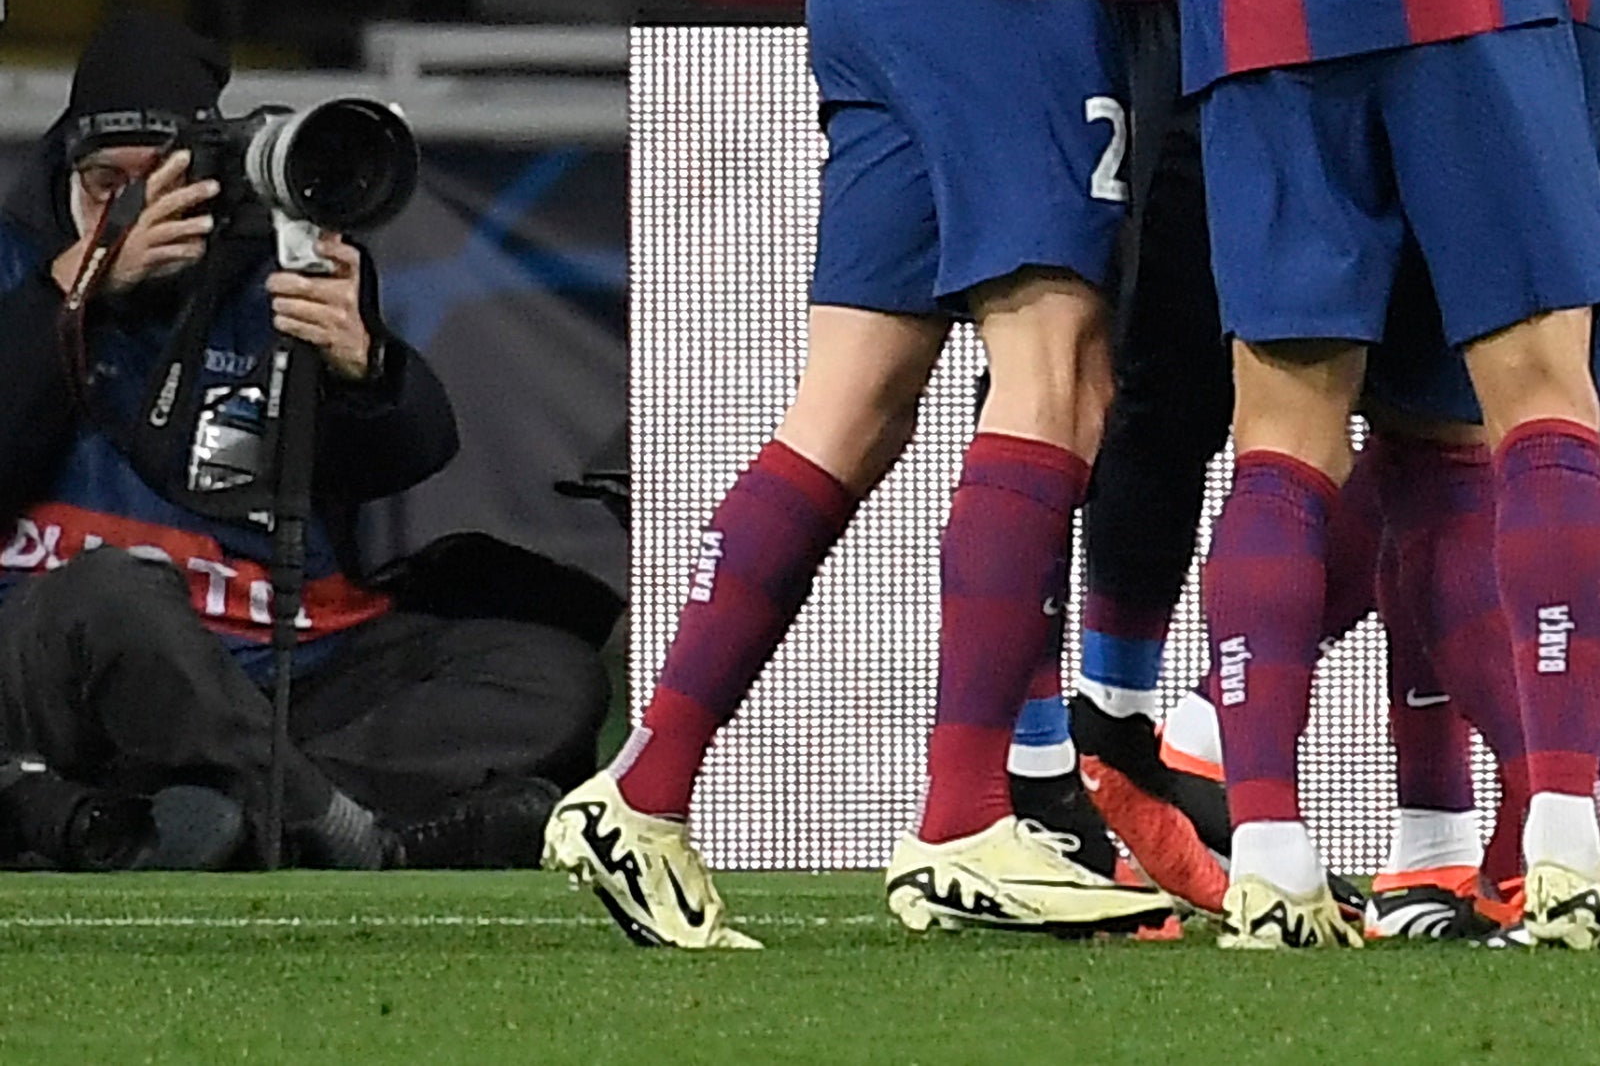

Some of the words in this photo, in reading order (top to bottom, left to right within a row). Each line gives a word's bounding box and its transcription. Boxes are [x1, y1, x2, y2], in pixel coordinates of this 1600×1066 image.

[1084, 95, 1129, 203] 2
[1219, 636, 1253, 707] BARÇA
[1537, 604, 1576, 673] BARÇA
